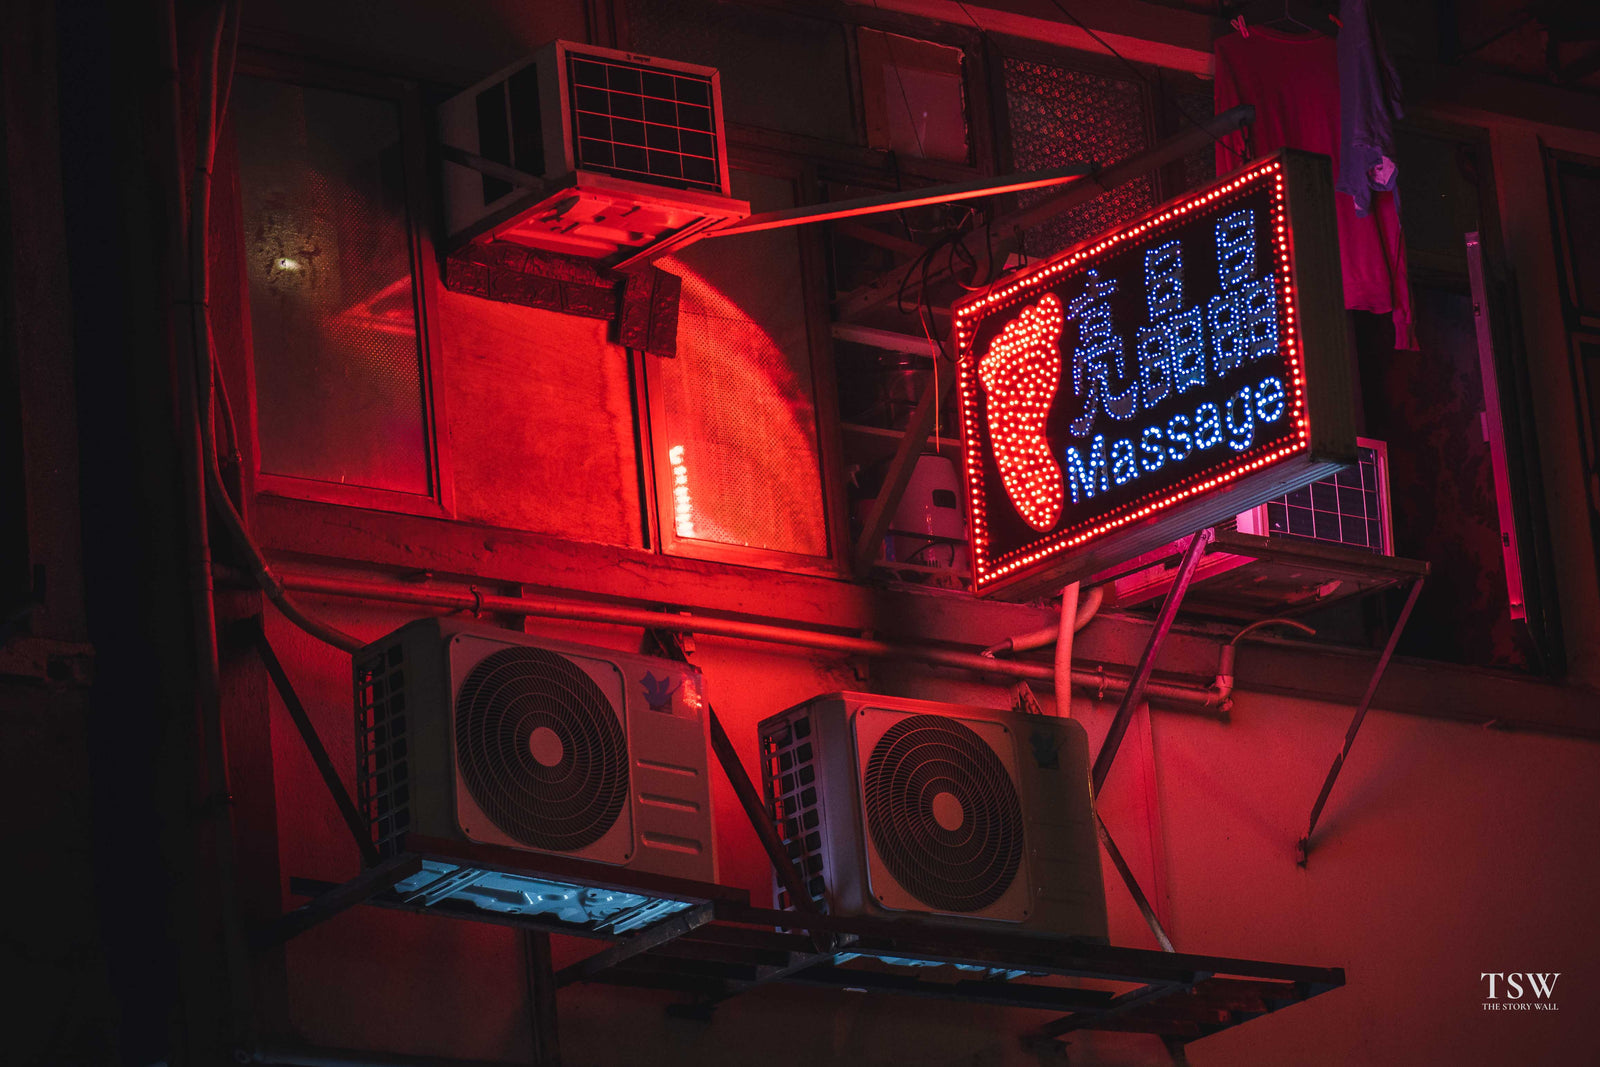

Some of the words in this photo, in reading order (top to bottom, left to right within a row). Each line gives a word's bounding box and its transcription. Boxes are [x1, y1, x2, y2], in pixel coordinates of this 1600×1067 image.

[1067, 210, 1279, 437] 亮晶晶
[1066, 377, 1284, 504] Massage
